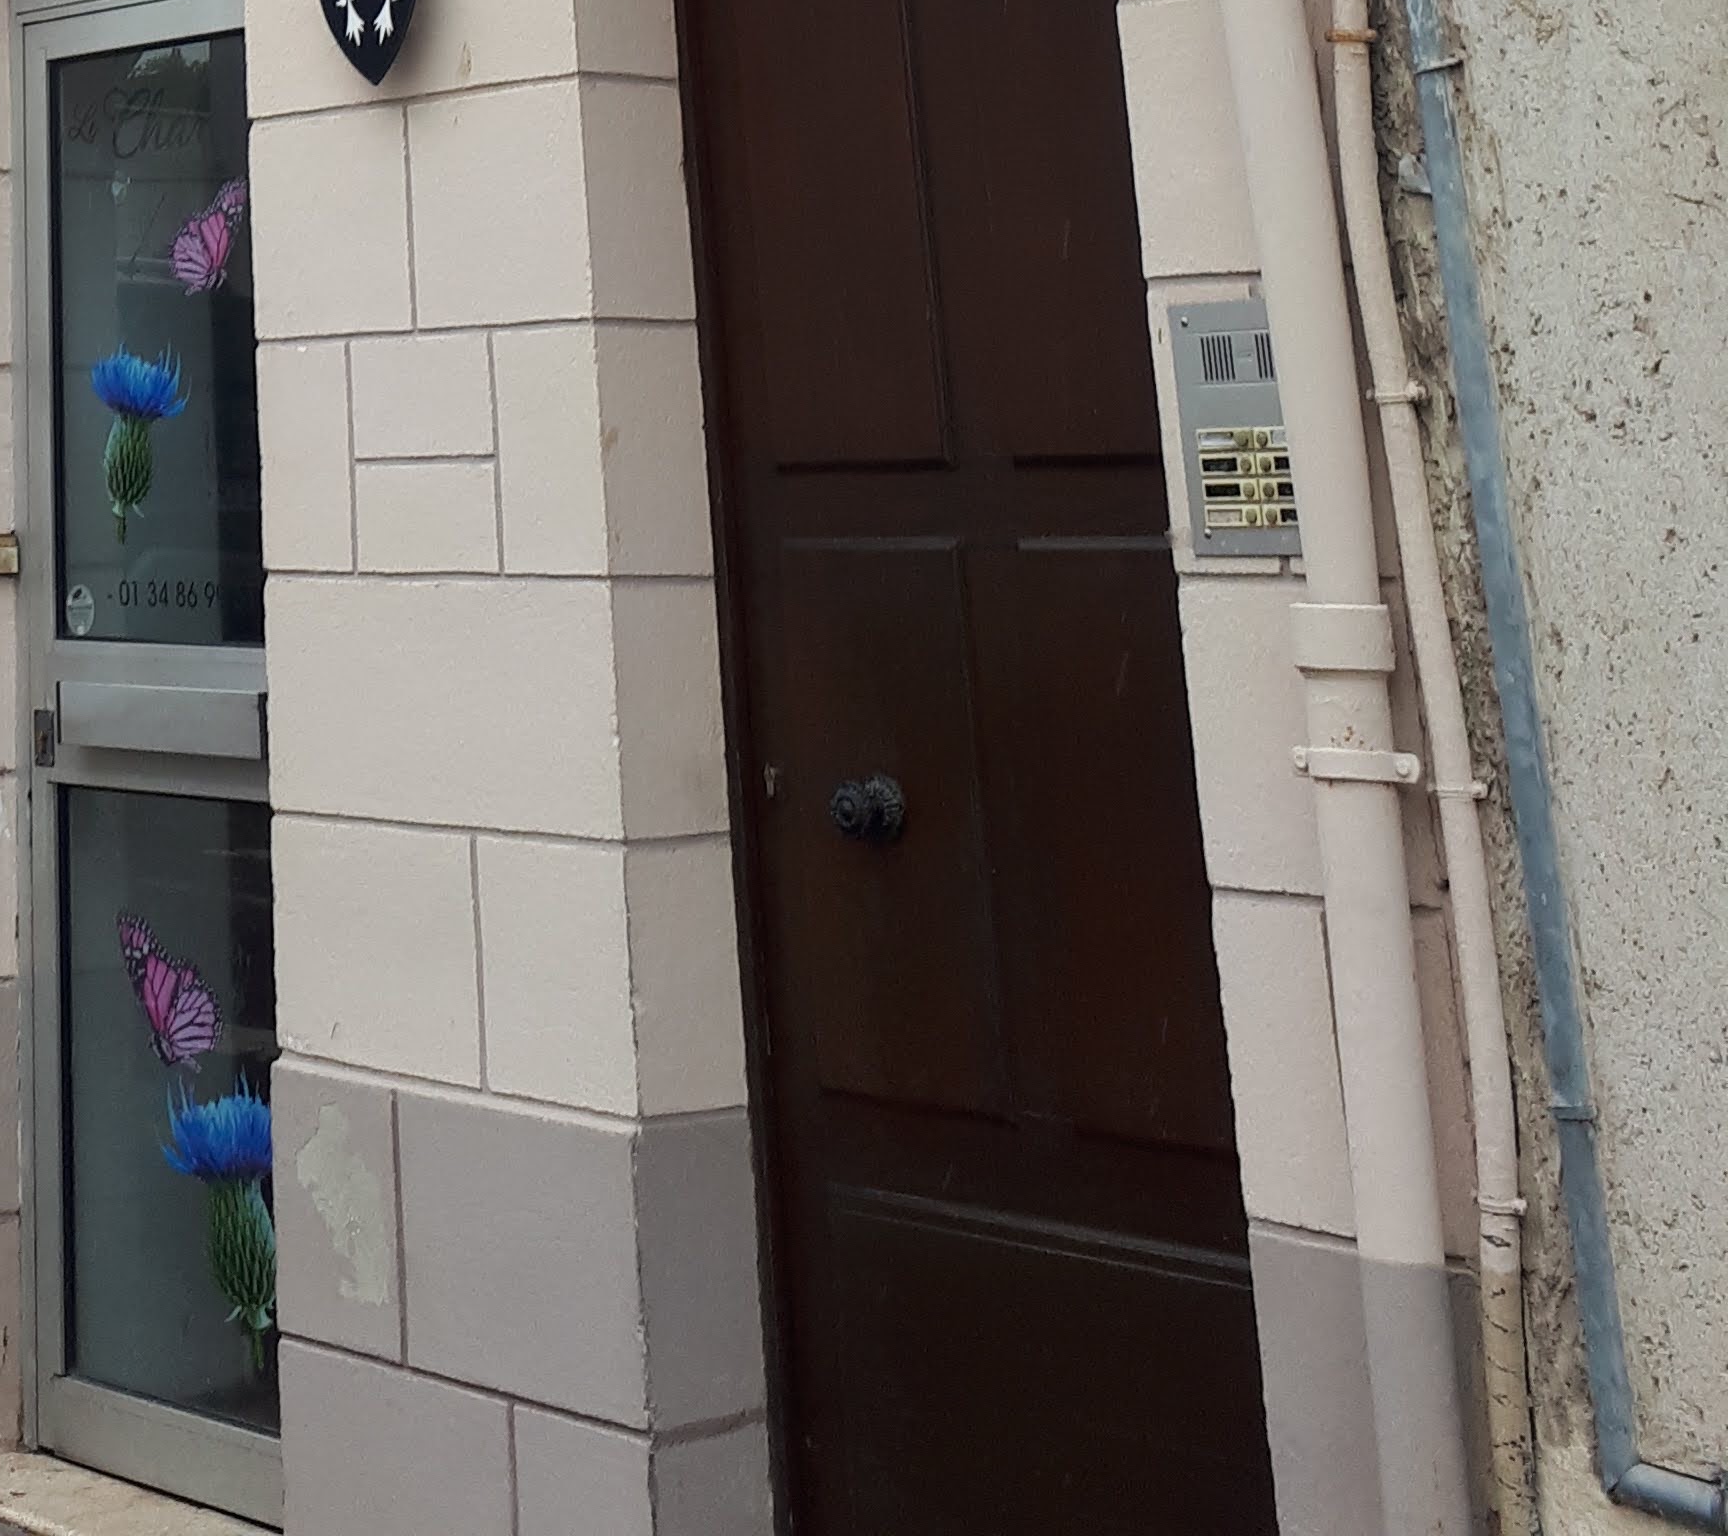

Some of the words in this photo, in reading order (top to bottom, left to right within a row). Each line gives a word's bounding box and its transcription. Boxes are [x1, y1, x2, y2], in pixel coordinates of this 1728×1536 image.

[119, 580, 138, 607] 01
[147, 580, 169, 609] 34
[175, 581, 198, 608] 86
